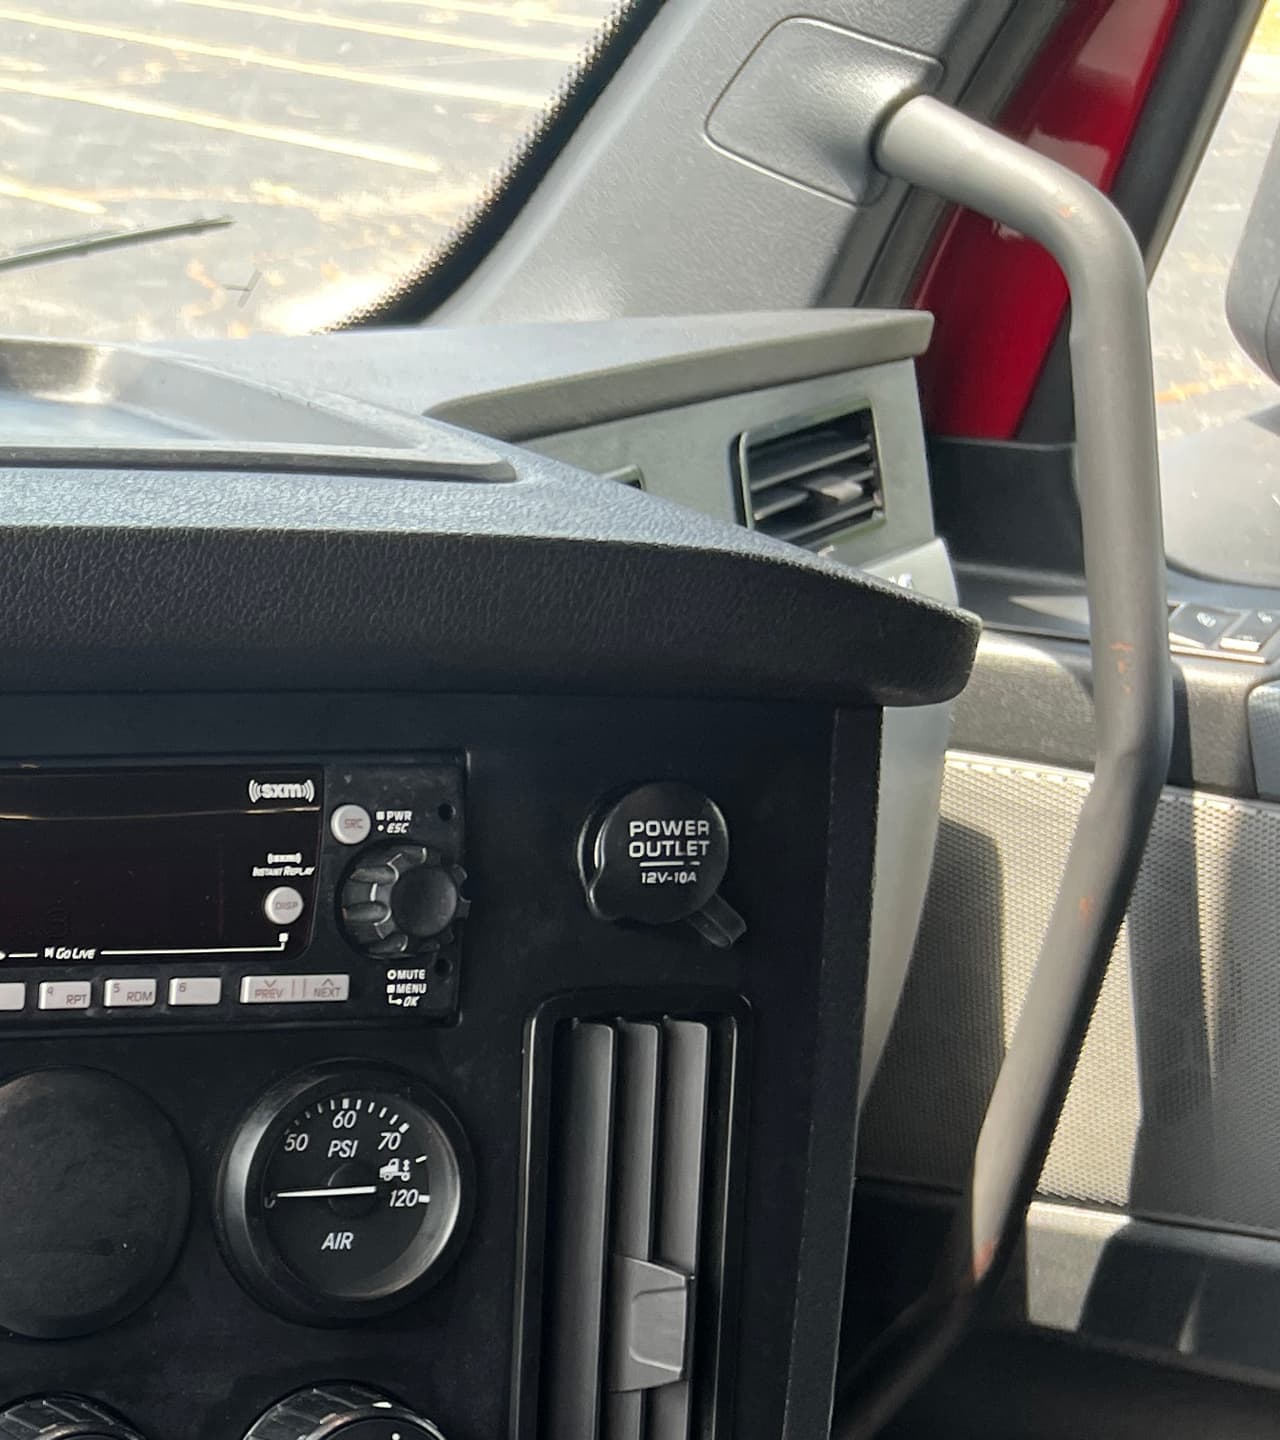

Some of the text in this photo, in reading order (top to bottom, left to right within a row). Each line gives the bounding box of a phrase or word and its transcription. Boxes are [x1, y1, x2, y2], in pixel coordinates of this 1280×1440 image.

[386, 811, 412, 821] PWR
[386, 823, 409, 834] ESC
[629, 820, 710, 837] POWER
[628, 840, 710, 858] OUTLET
[641, 872, 697, 884] 12V-10A
[397, 969, 426, 980] MUTE
[46, 985, 54, 996] 4
[112, 983, 121, 994] 5
[178, 982, 187, 993] 6
[254, 987, 283, 999] PREV
[313, 986, 342, 998] NEXT
[396, 983, 427, 994] MENU
[65, 994, 88, 1006] RPT
[126, 991, 153, 1003] RDM
[403, 996, 420, 1007] OK
[332, 1110, 357, 1129] 60
[284, 1133, 308, 1152] 50
[377, 1132, 402, 1150] 70
[327, 1140, 359, 1158] PSI
[389, 1189, 419, 1207] 120
[321, 1232, 354, 1250] AIR
